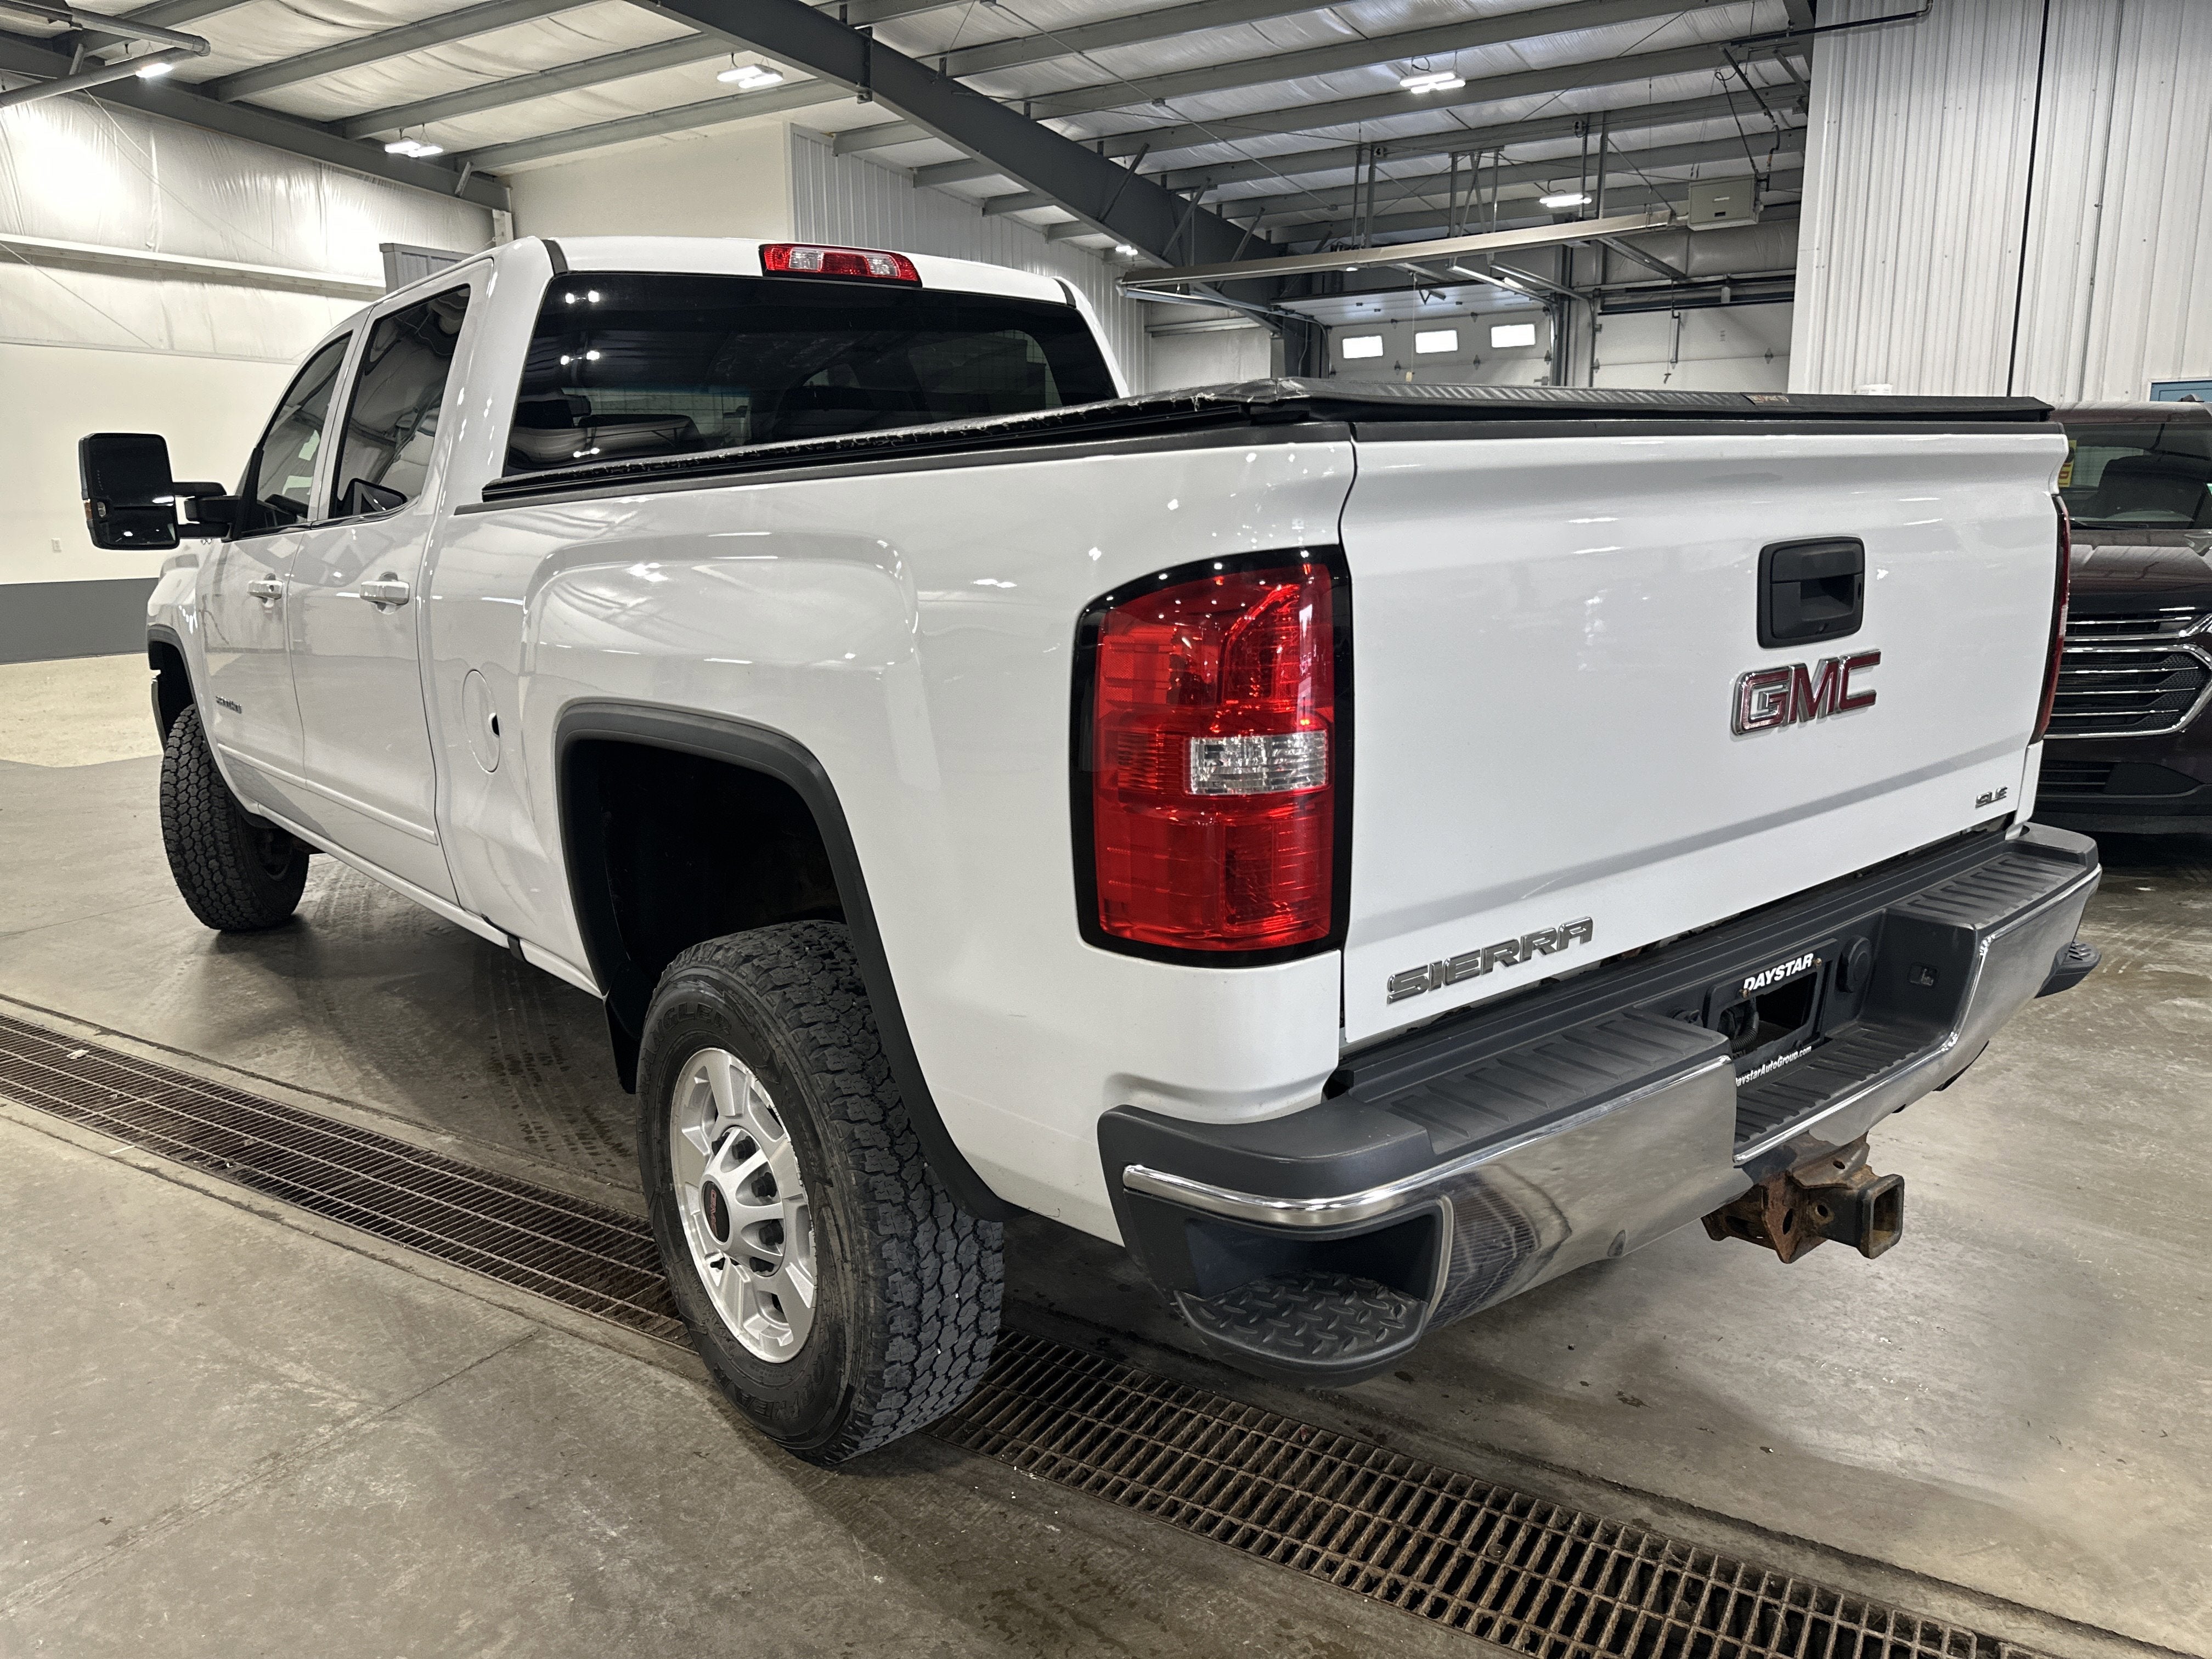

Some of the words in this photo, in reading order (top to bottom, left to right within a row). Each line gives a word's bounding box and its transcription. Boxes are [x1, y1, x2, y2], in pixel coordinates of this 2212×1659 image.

[1730, 648, 1881, 736] GMC
[1387, 916, 1593, 1005] SIERRA
[1743, 953, 1814, 990] DAYSTAR
